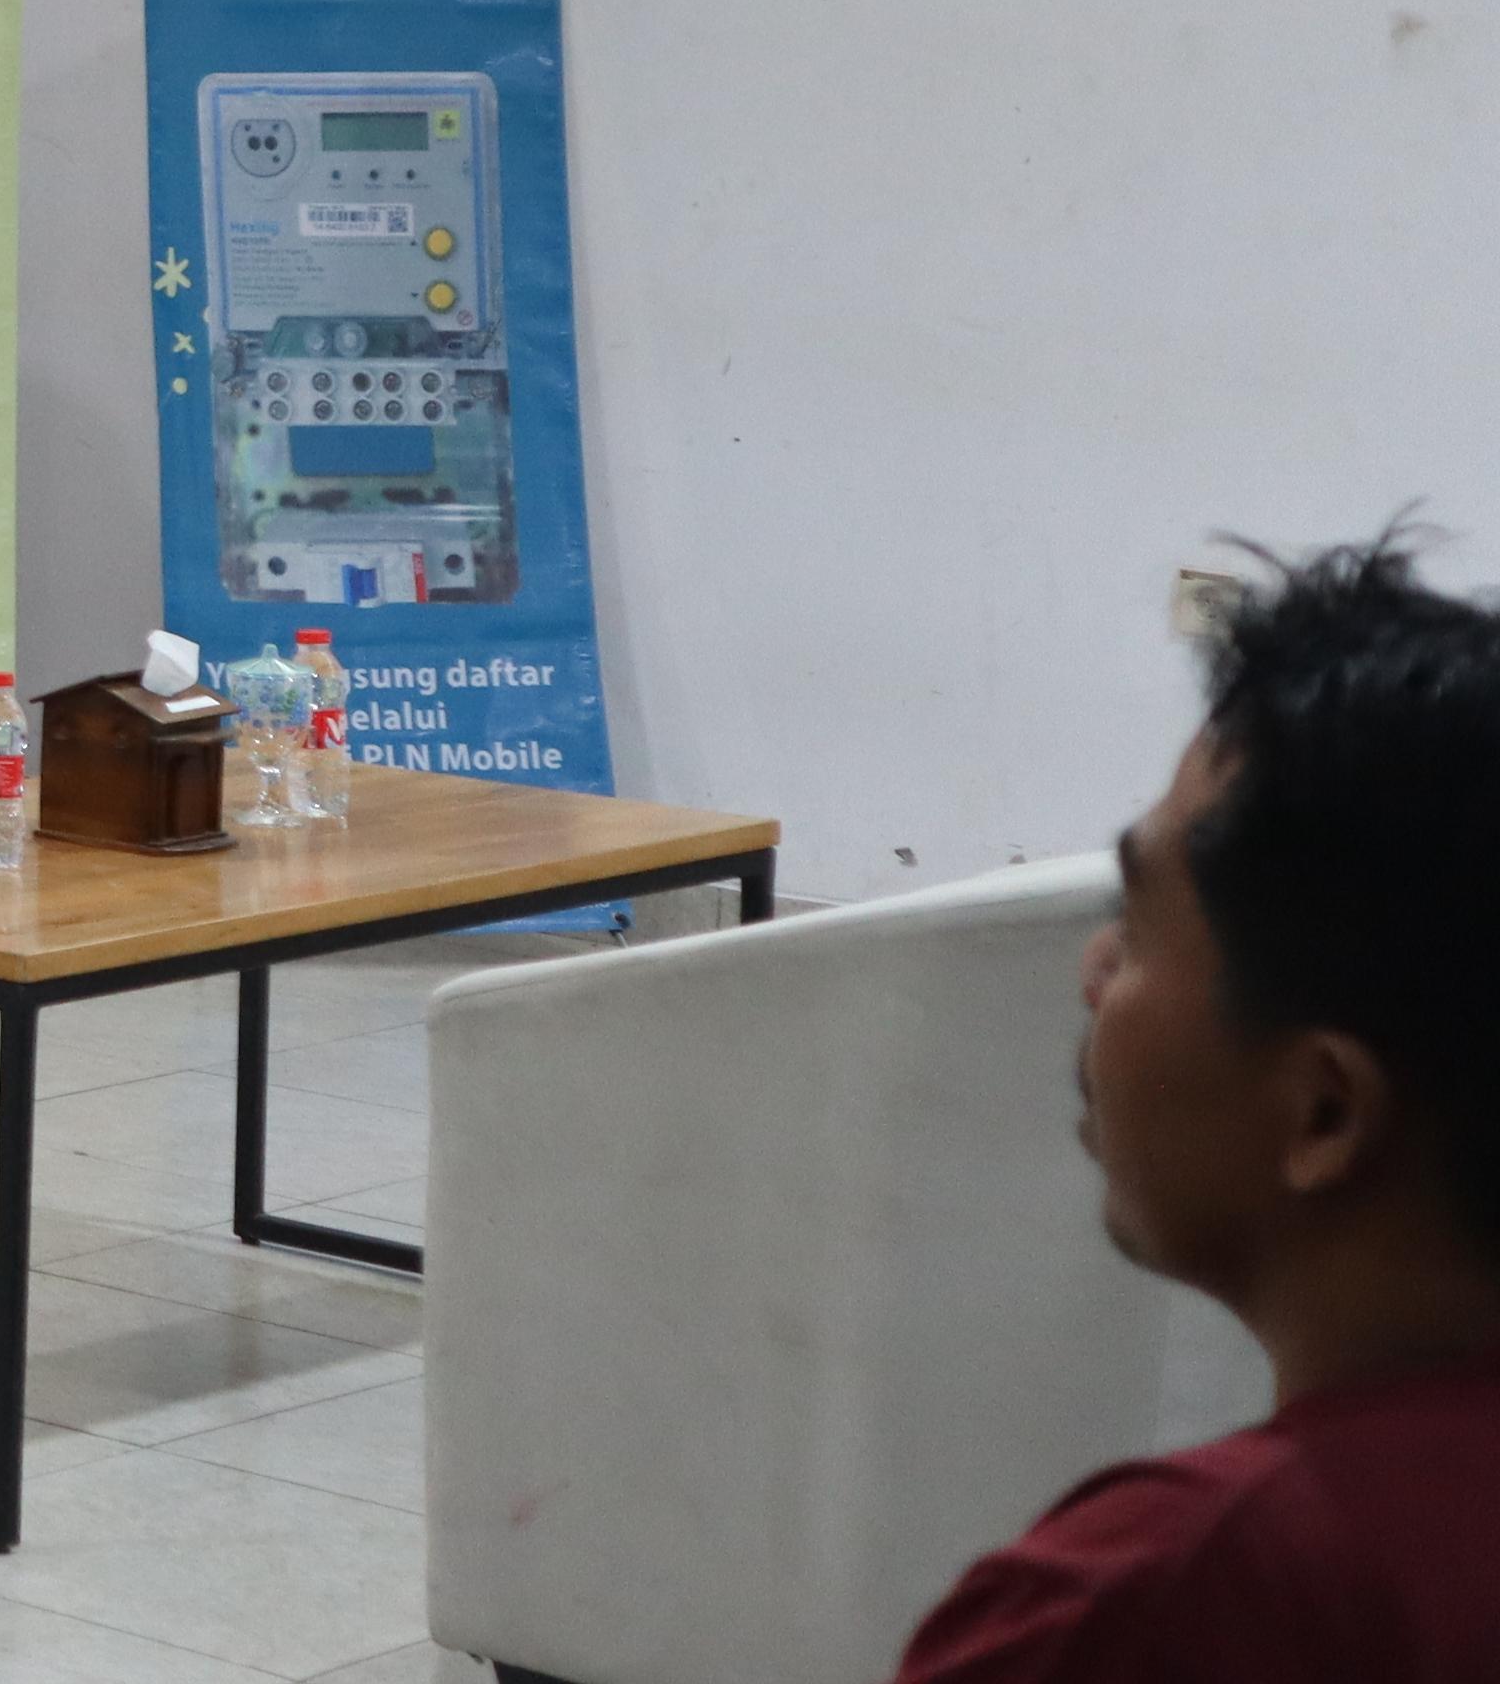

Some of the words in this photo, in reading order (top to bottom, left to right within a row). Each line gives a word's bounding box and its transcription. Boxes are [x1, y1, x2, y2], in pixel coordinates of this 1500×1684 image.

[446, 658, 555, 688] daftar
[363, 743, 430, 771] PLN
[440, 741, 564, 771] Mobile
